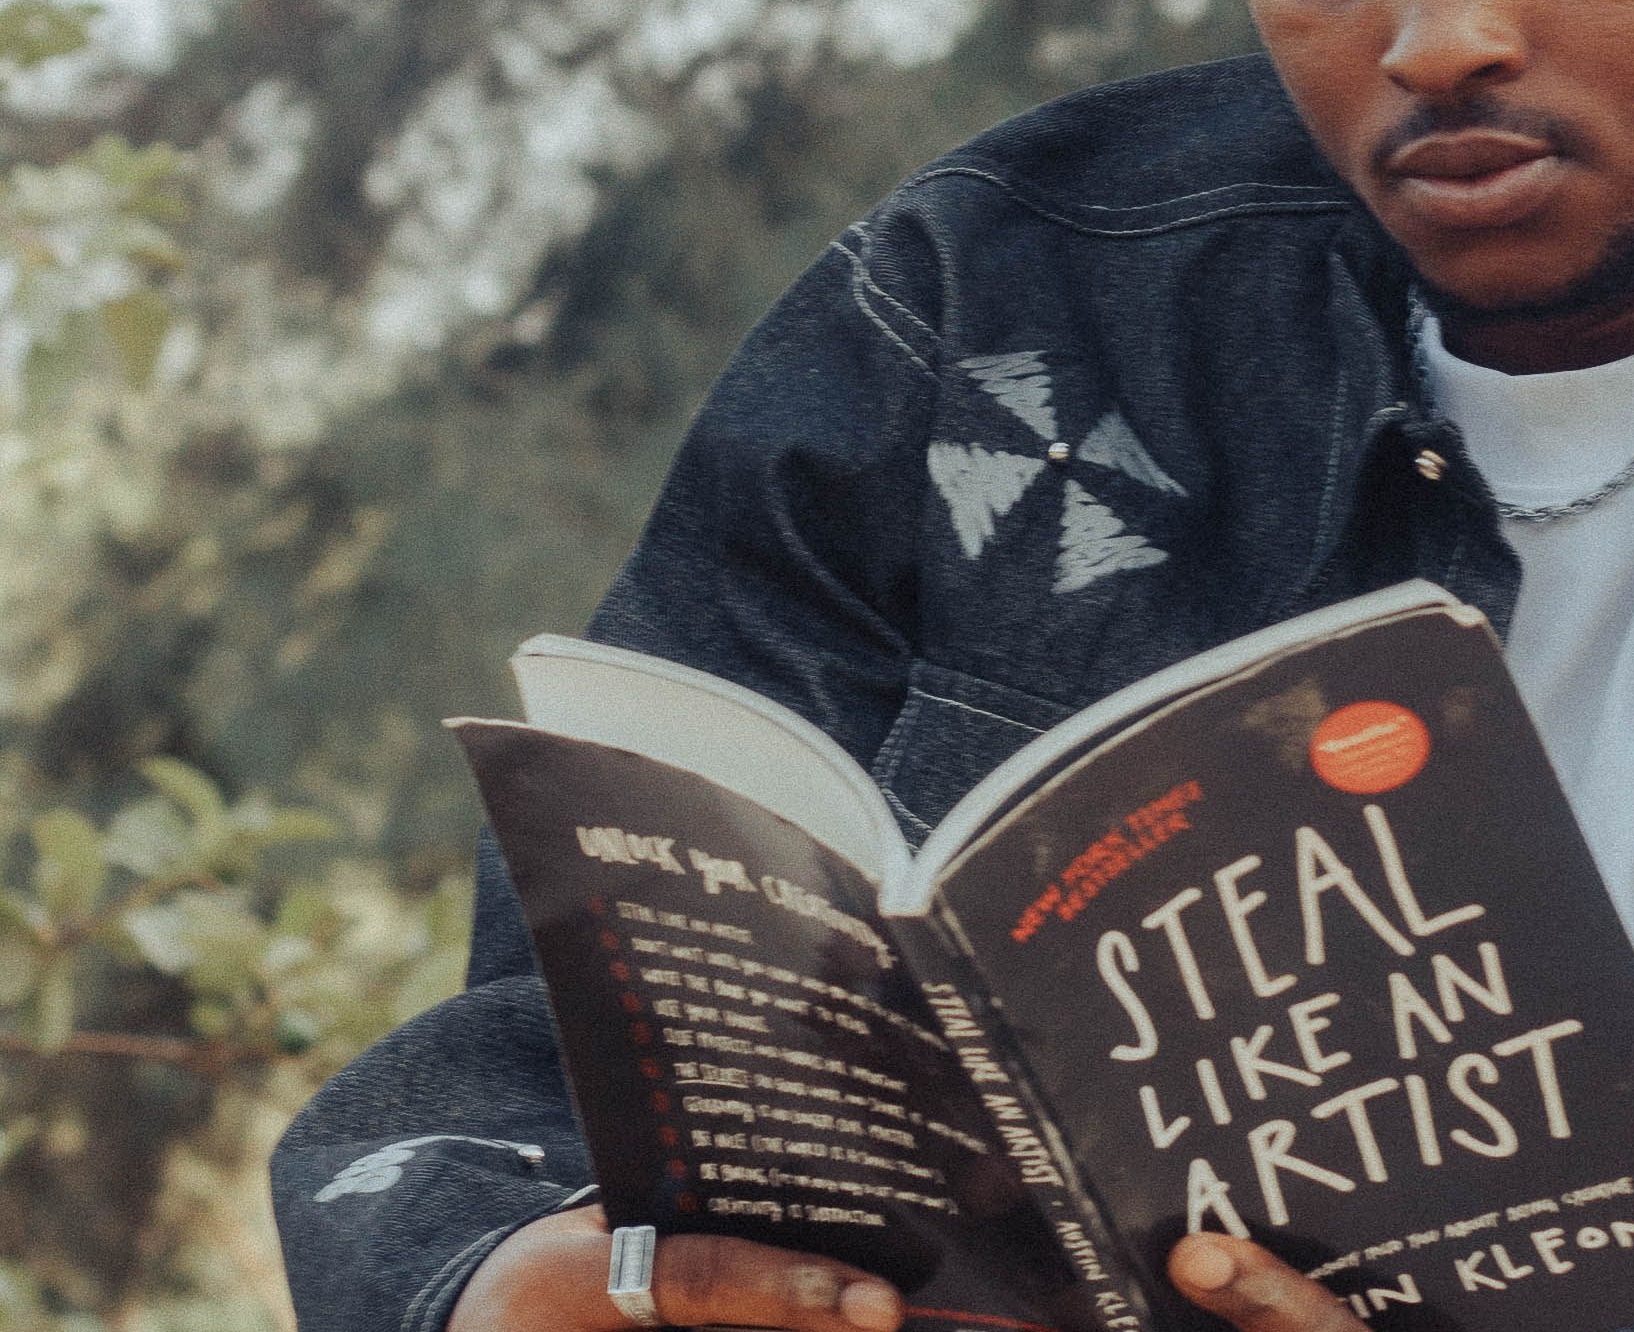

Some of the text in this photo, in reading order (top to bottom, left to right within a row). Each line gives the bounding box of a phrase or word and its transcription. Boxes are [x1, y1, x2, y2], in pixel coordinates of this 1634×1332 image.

[1097, 804, 1486, 1061] STEAL
[921, 981, 985, 1038] STEAL
[957, 1046, 1009, 1083] LIKE
[1140, 942, 1513, 1148] LIKE AN
[982, 1093, 1027, 1120] AN
[1187, 1019, 1584, 1238] ARTIST
[999, 1125, 1064, 1186] ARTIST
[1056, 1220, 1109, 1281] AUSTIN
